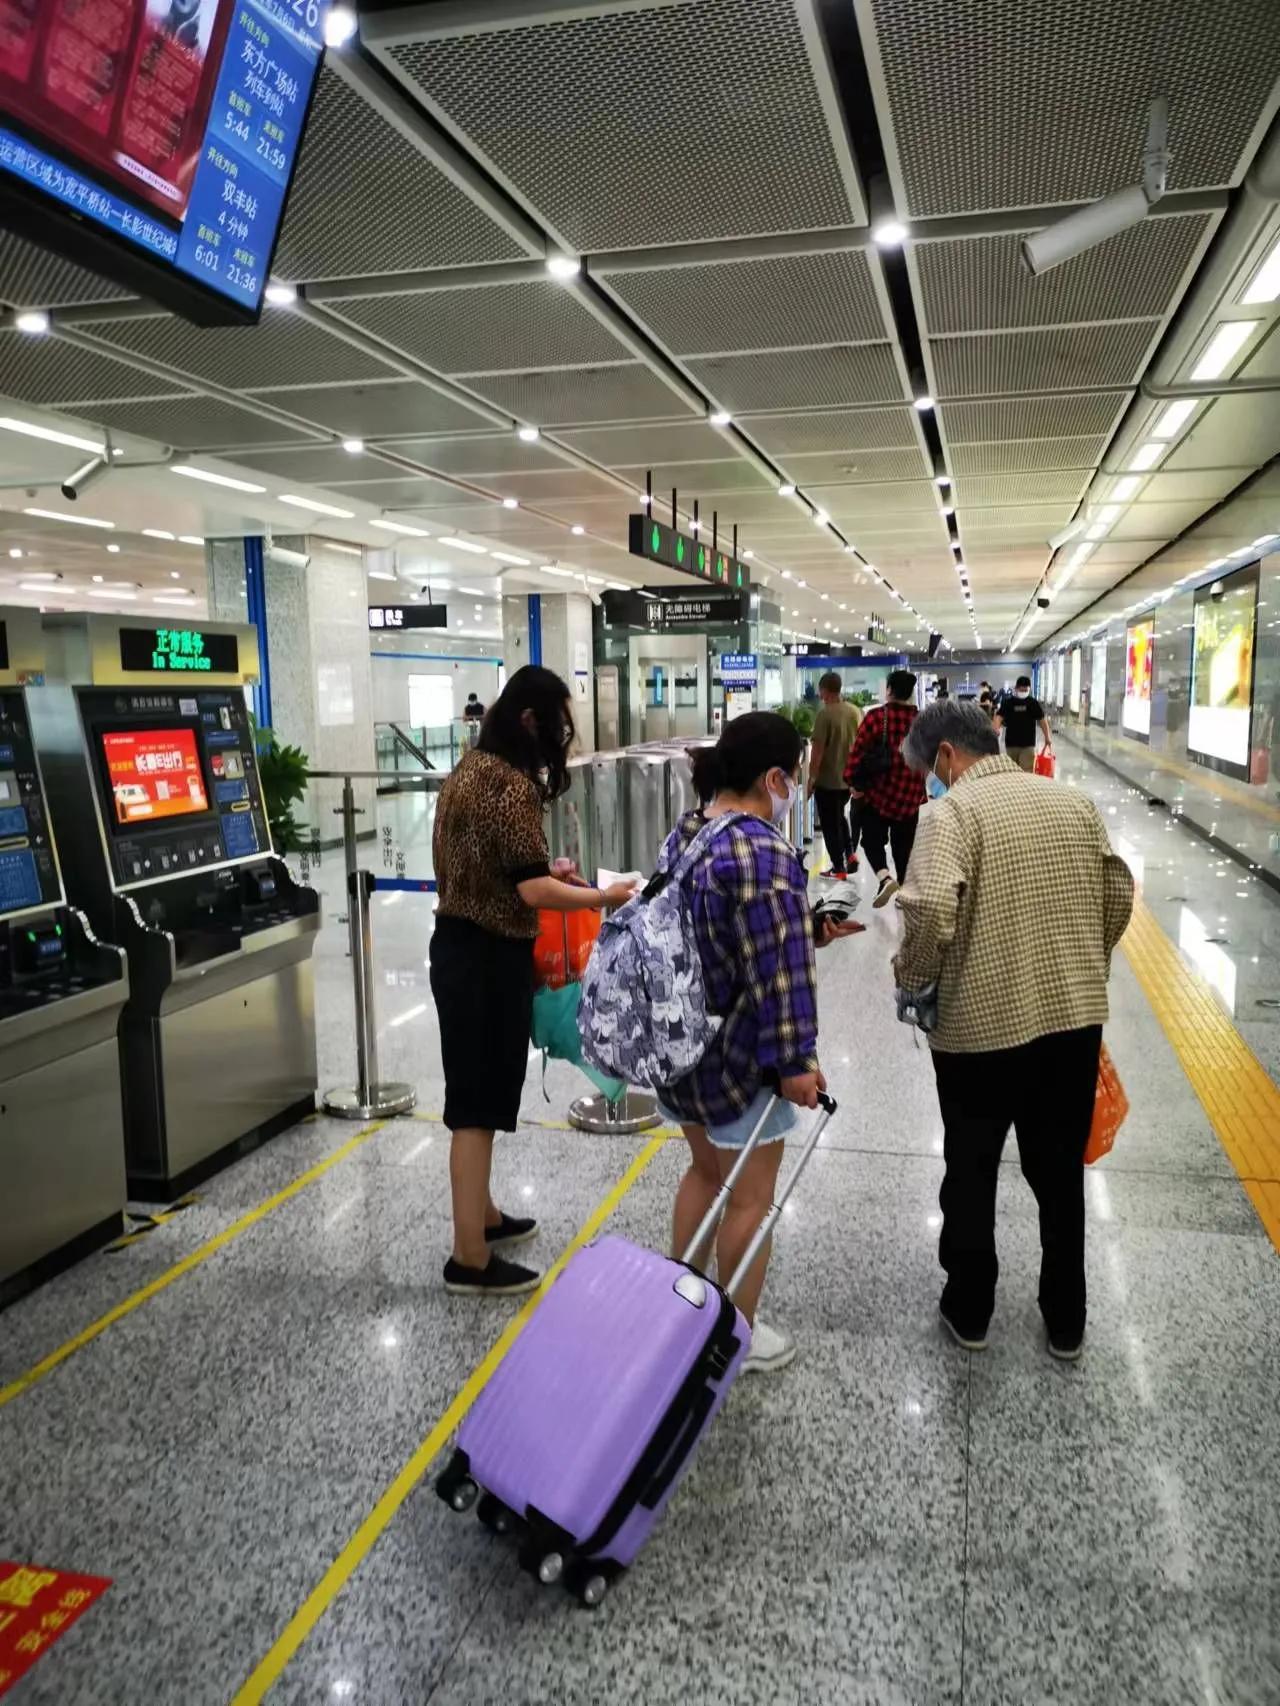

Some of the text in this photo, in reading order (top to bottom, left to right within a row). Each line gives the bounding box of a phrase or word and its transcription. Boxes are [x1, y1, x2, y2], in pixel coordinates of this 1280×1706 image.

[241, 39, 299, 104] 东方广场站
[224, 111, 250, 142] 5:44
[207, 146, 239, 179] 开往方向
[256, 136, 287, 170] 21:59
[221, 179, 258, 221] 双丰站
[218, 210, 249, 242] 4 分钟
[195, 245, 220, 271] 6:01
[226, 264, 257, 292] 21:36
[665, 603, 711, 614] 无障碍电梯
[156, 628, 205, 656] 正常服务
[152, 651, 212, 671] In Service
